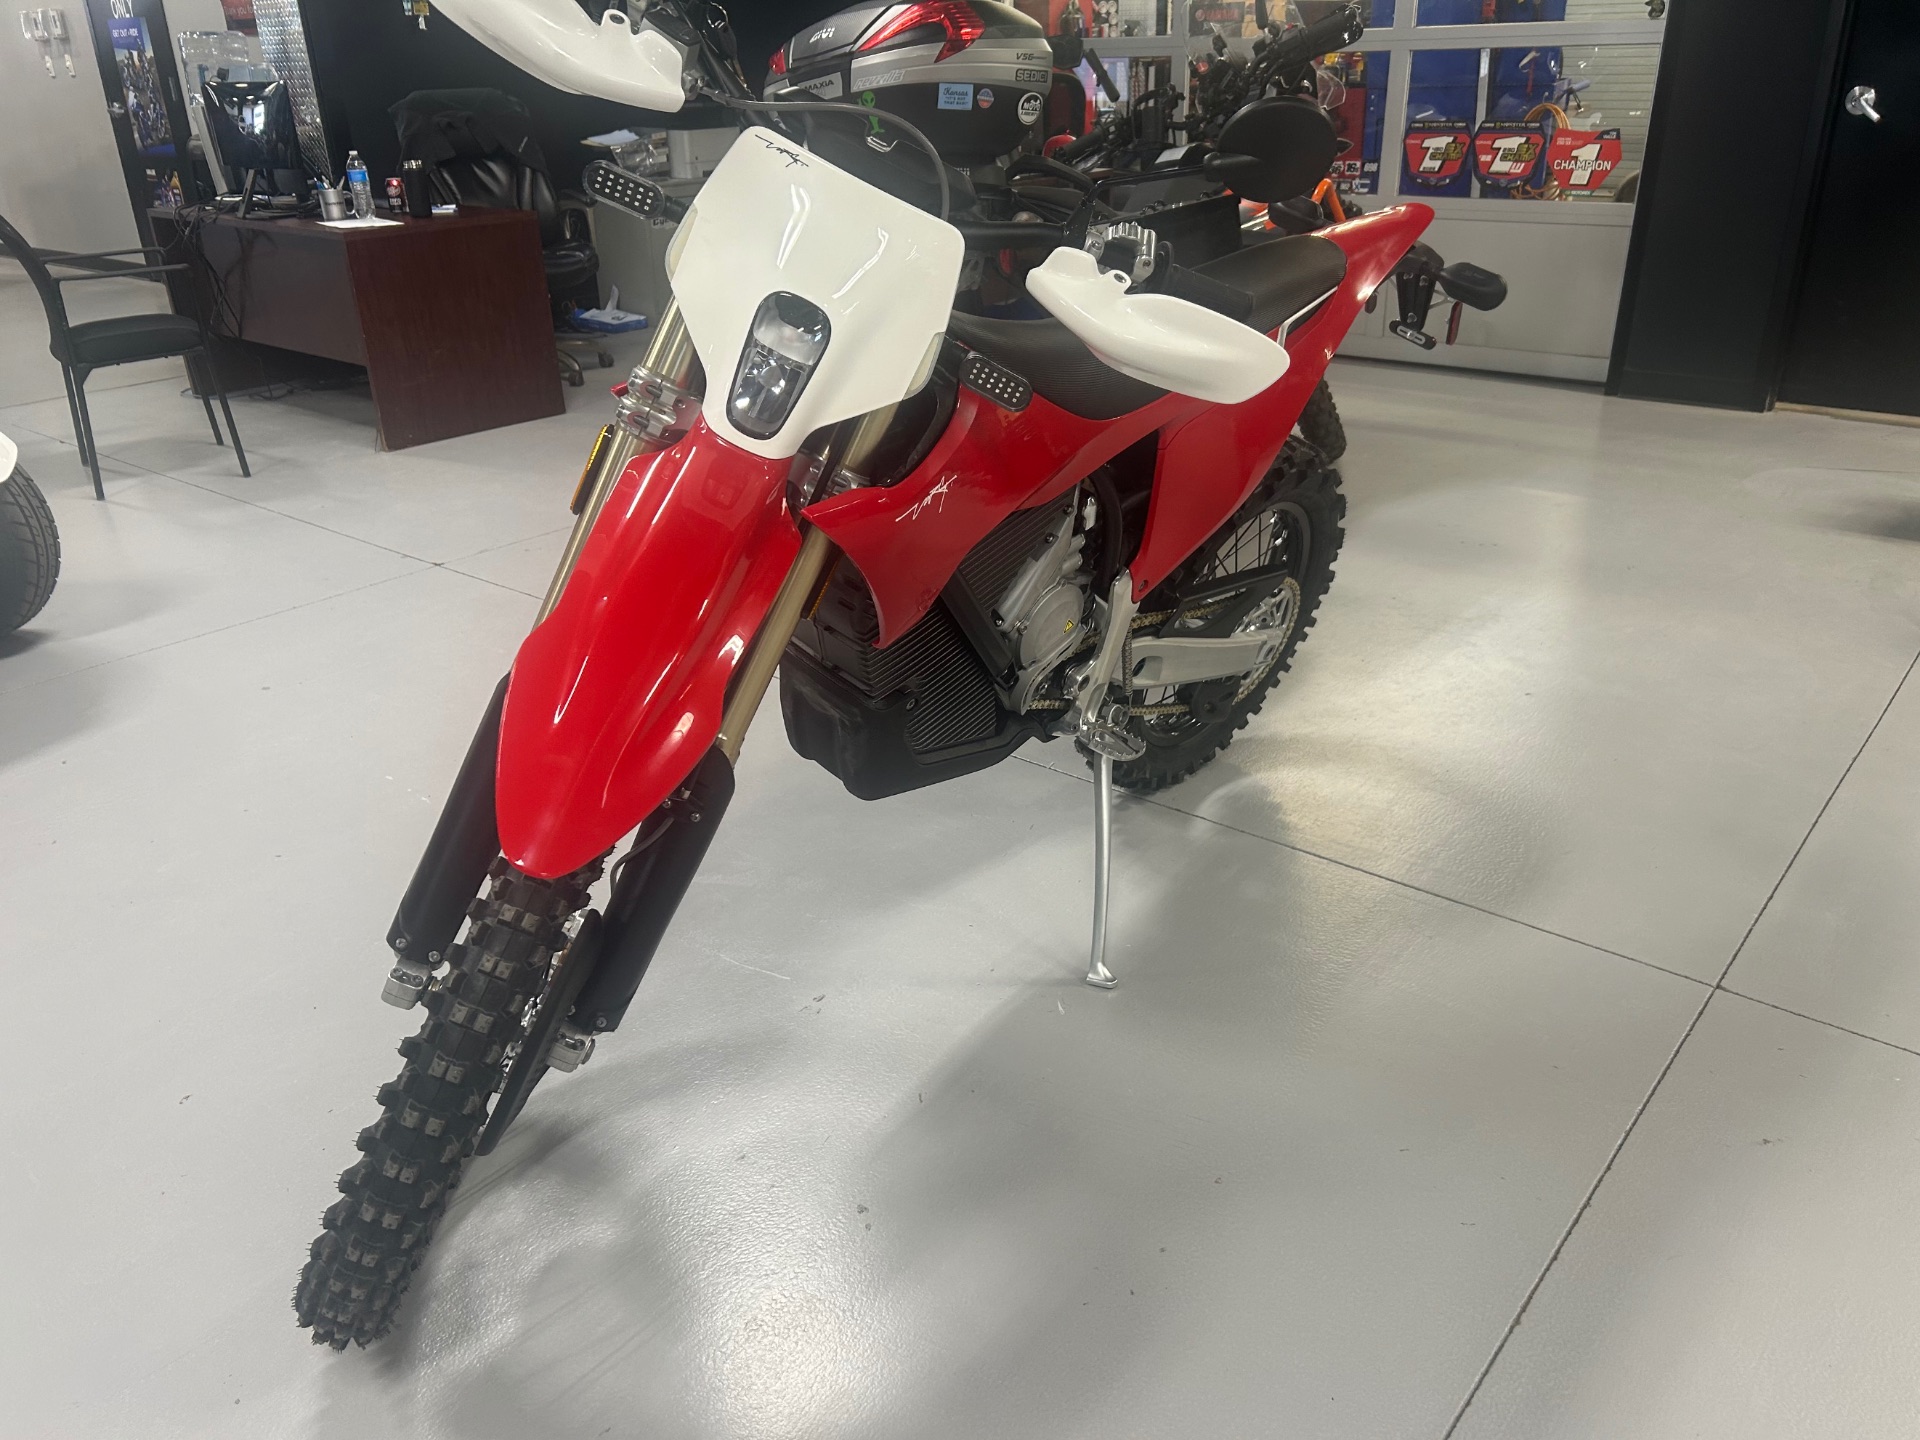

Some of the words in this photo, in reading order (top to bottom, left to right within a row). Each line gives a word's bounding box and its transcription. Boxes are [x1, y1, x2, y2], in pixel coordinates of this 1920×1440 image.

[110, 0, 134, 19] ONLY
[809, 27, 835, 43] GIVI
[1015, 69, 1048, 83] SEDICI
[804, 79, 834, 91] MAXIA
[943, 86, 968, 97] Kansas
[1023, 102, 1041, 111] MOTO
[1419, 136, 1455, 172] 1
[1429, 151, 1462, 161] CHAMP
[1489, 136, 1527, 174] 1
[1500, 152, 1536, 162] CHAMP
[1553, 159, 1612, 171] CHAMPION
[1568, 143, 1602, 186] 1
